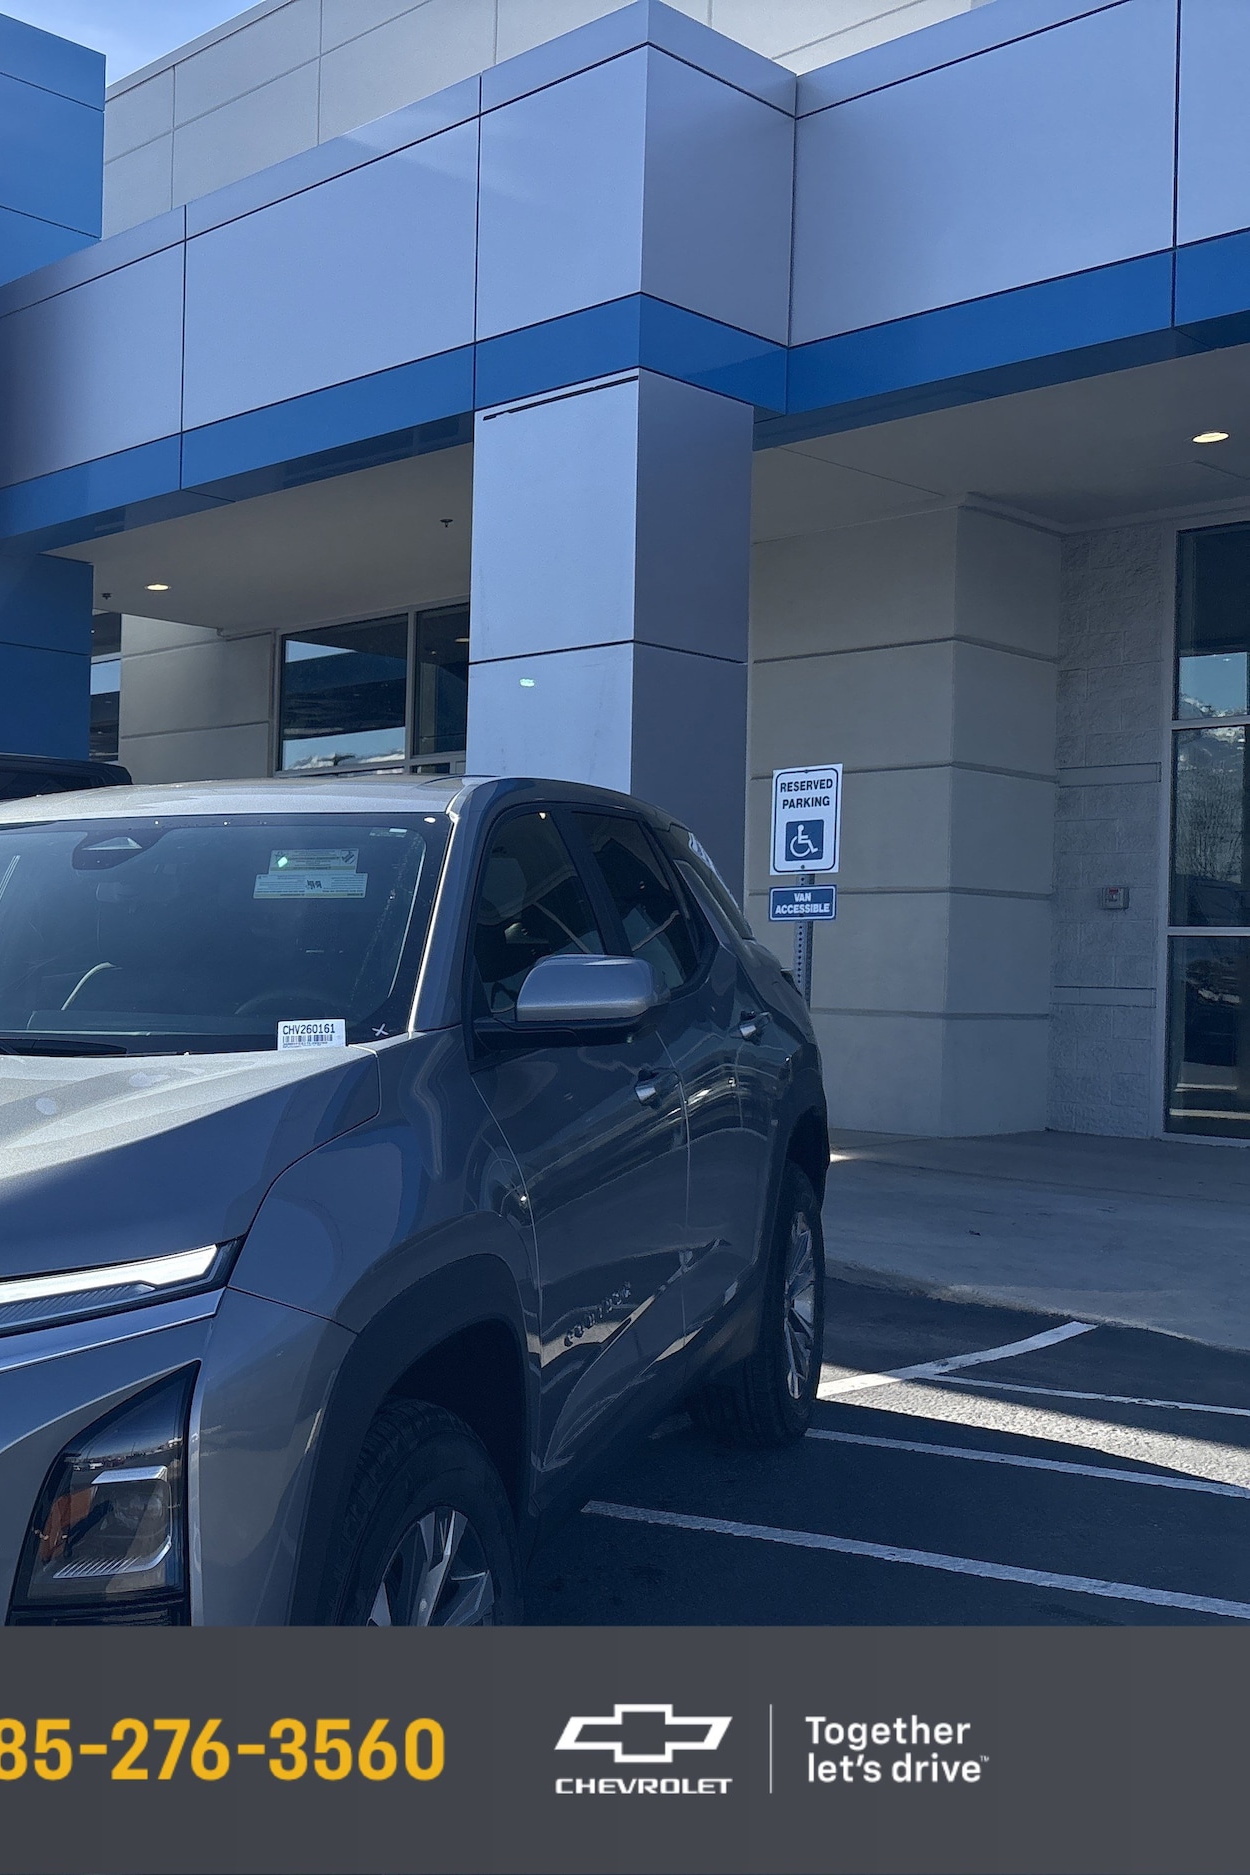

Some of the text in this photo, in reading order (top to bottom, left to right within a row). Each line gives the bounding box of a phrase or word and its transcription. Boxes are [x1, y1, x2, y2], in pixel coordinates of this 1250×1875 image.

[780, 779, 833, 793] RESERVED
[782, 796, 830, 809] PARKING
[794, 893, 811, 902] VAN
[775, 903, 830, 914] ACCESSIBLE
[283, 1023, 336, 1035] CHV260161
